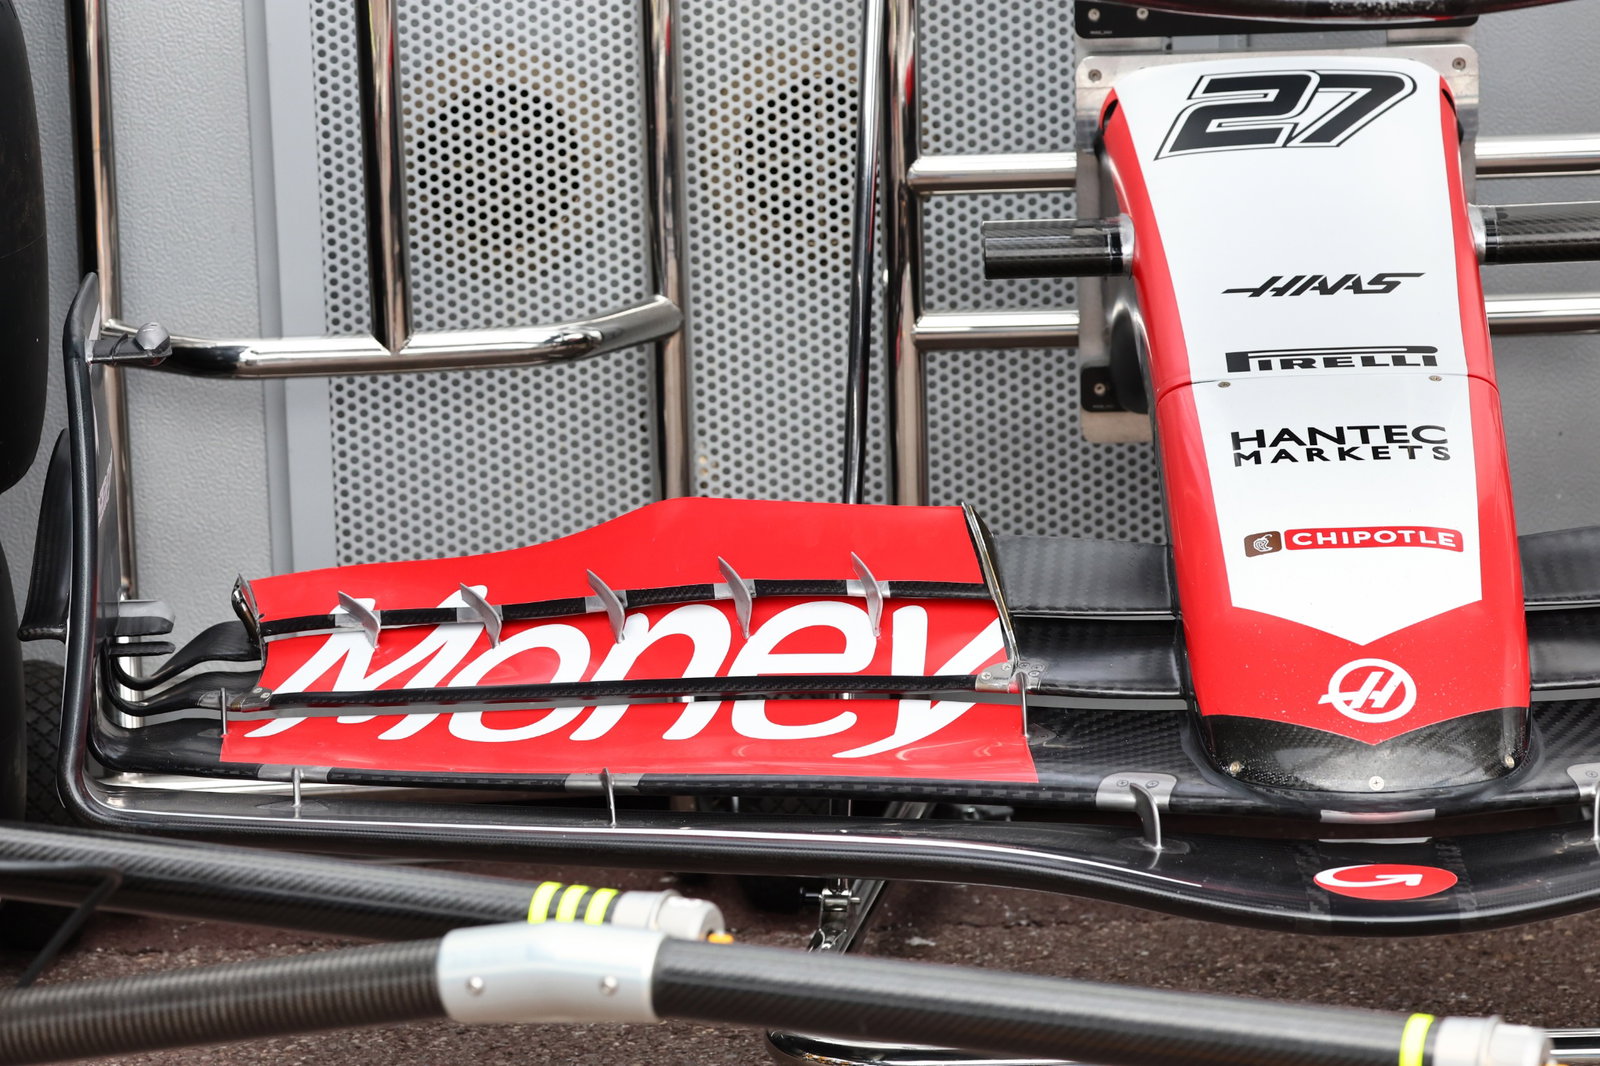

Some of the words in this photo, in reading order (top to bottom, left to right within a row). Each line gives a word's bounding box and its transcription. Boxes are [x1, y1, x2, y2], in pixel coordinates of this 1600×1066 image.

[1154, 70, 1418, 161] 27
[1222, 272, 1425, 298] HAAS
[1225, 345, 1438, 373] PIRELLI
[1230, 424, 1448, 451] HANTEC
[1233, 445, 1451, 467] MARKETS
[1291, 529, 1457, 548] CHIPOTLE
[243, 584, 1005, 759] Money
